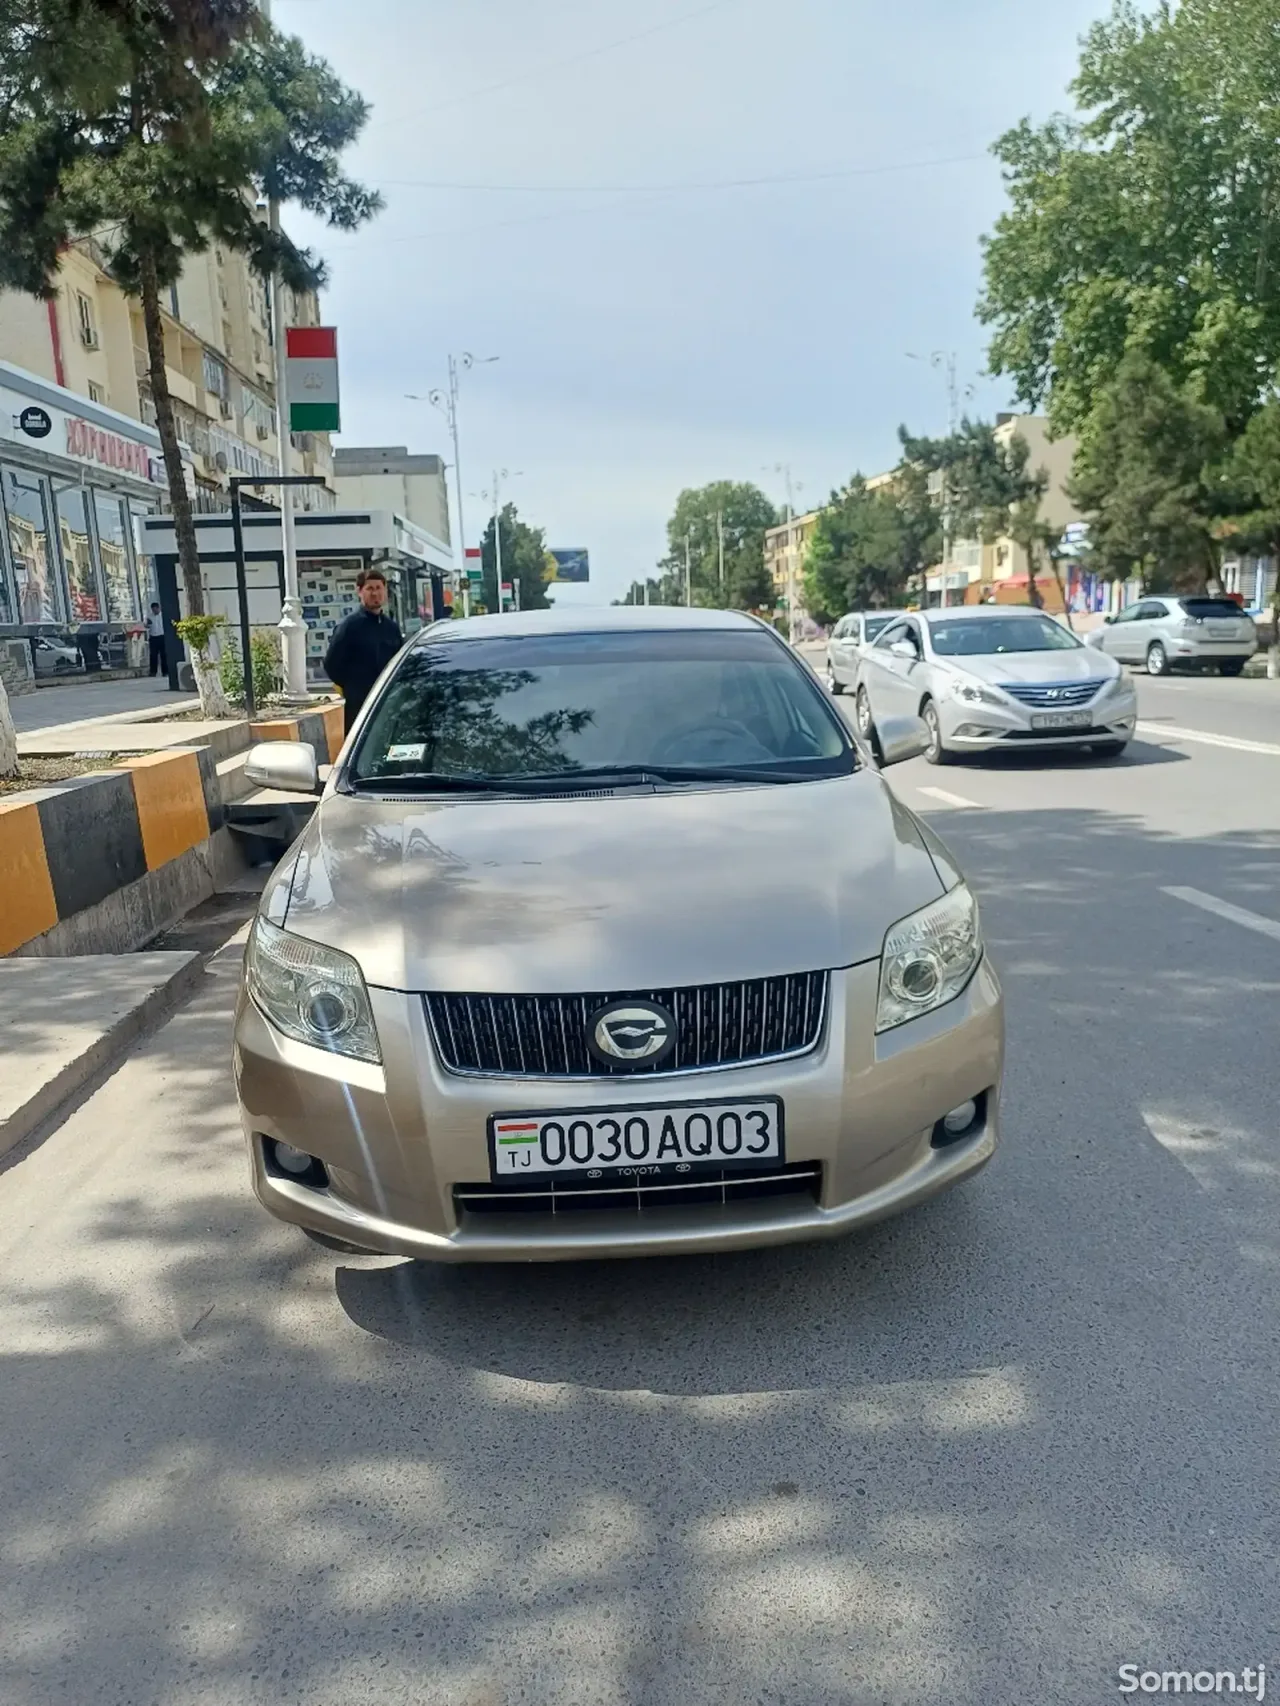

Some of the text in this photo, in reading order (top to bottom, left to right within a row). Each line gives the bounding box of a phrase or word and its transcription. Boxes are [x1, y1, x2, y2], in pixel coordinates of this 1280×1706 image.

[539, 1110, 770, 1165] 0030AQ03
[507, 1150, 532, 1168] TJ
[616, 1165, 661, 1176] TOYOTA
